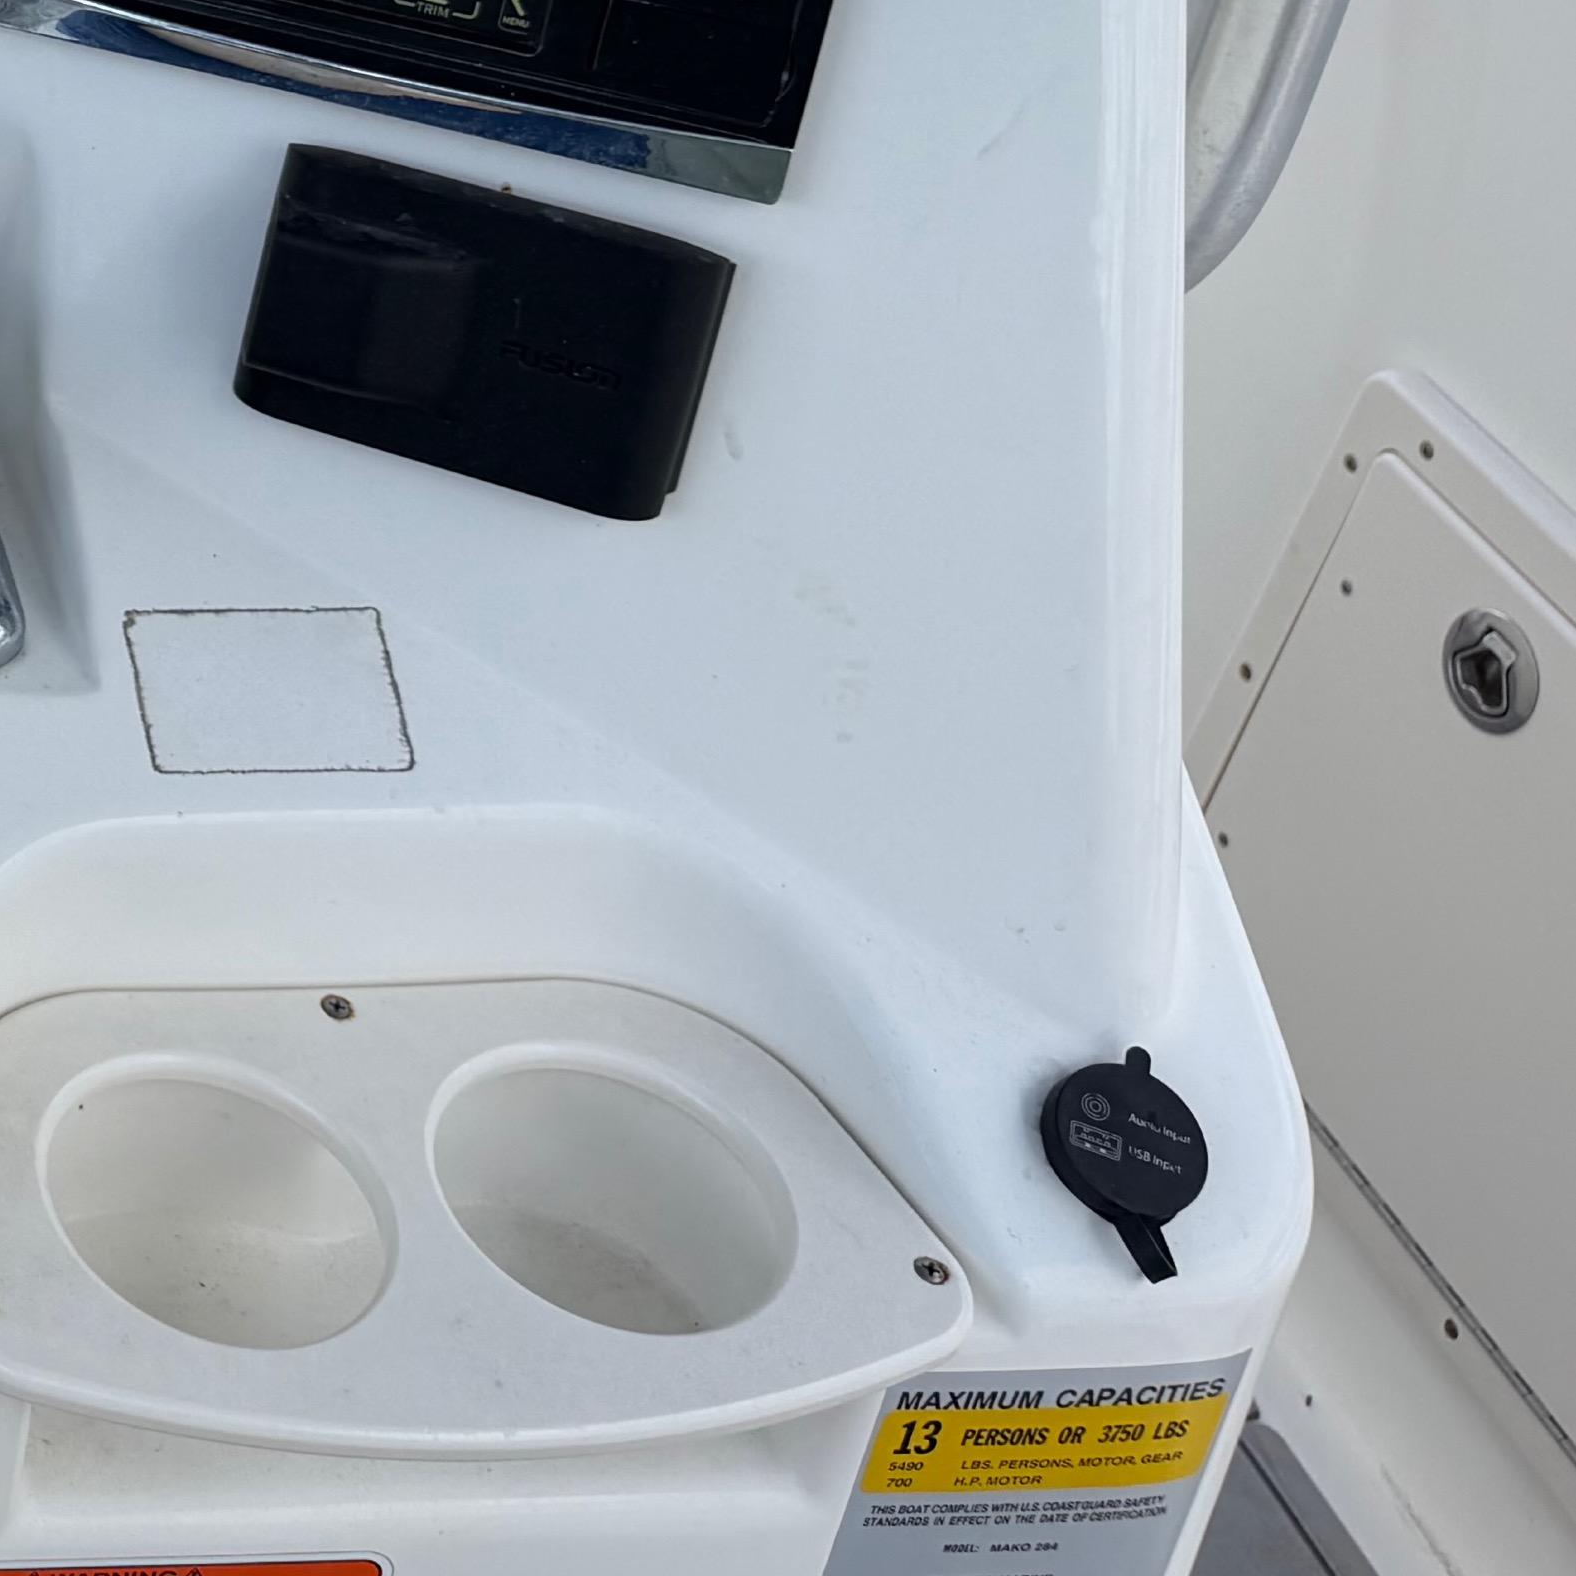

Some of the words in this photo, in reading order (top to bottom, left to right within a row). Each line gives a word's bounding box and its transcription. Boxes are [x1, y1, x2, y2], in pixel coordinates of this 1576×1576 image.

[416, 1, 450, 18] TRIM
[500, 340, 622, 391] FUSION
[896, 1390, 1045, 1411] MAXIMUM
[1055, 1378, 1226, 1409] CAPACITIES
[892, 1420, 943, 1455] 13
[960, 1427, 1050, 1447] PERSONS
[1057, 1425, 1086, 1445] OR
[1097, 1423, 1145, 1444] 3750
[1152, 1420, 1189, 1440] LBS
[888, 1462, 924, 1472] 5490
[961, 1460, 994, 1470] LBS.
[1141, 1451, 1183, 1465] GEAR
[887, 1477, 913, 1488] 700
[985, 1475, 1043, 1487] MOTOR
[990, 1542, 1031, 1552] MAKO
